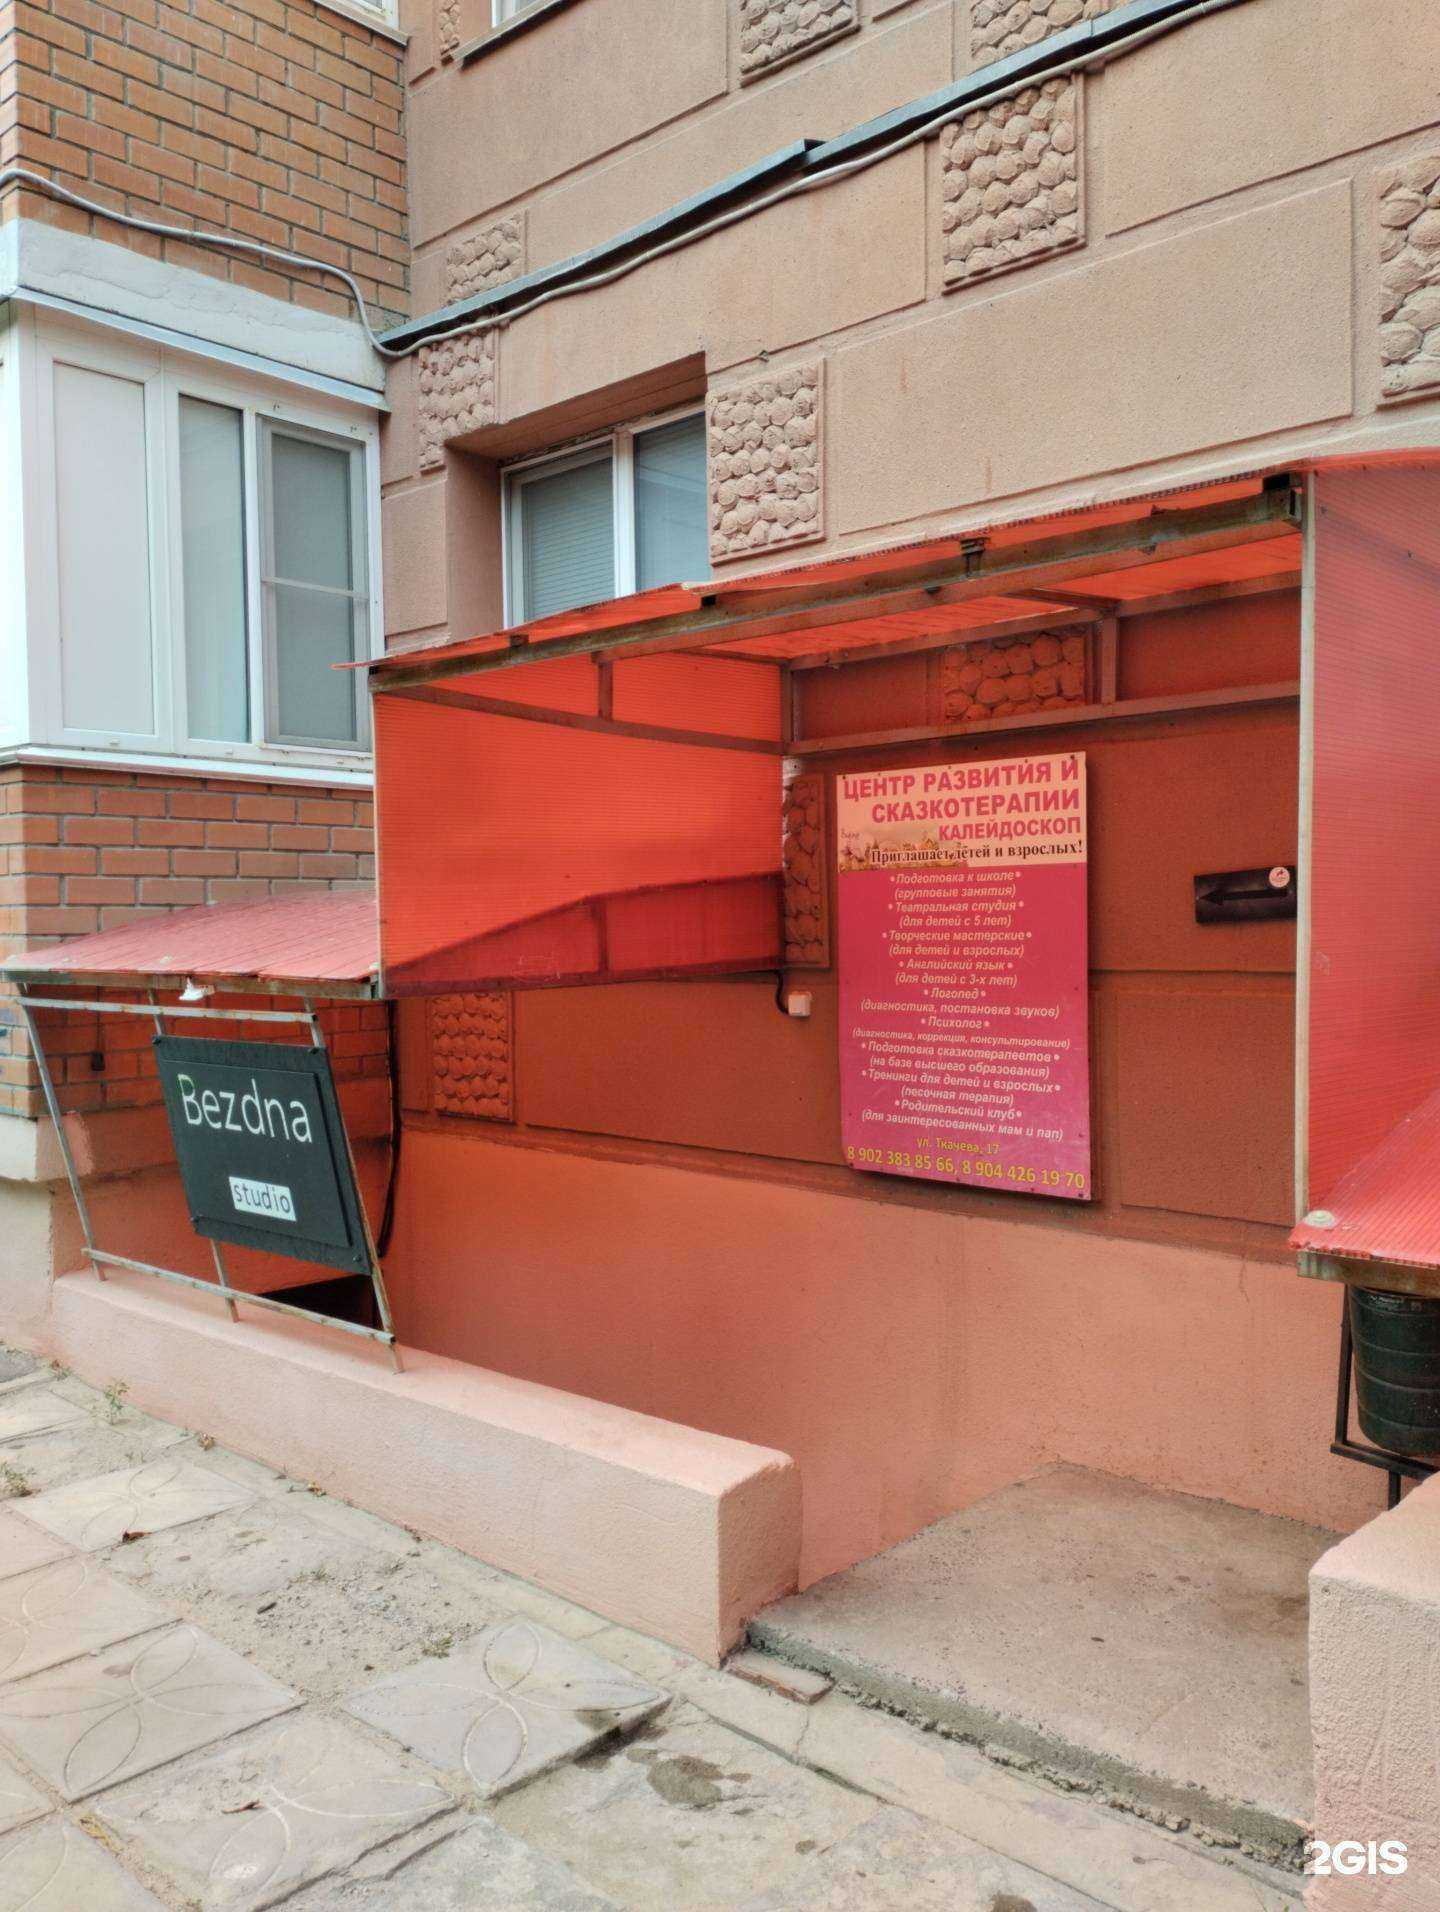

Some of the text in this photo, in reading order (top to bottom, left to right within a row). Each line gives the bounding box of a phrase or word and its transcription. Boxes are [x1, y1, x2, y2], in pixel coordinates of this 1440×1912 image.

[844, 760, 1079, 802] ЦЕНТР РАЗВИТИЯ И
[872, 788, 1079, 823] СКАЗКОТЕРАПИИ
[939, 817, 1081, 841] КАЛЕЙДОСКОП
[872, 840, 1083, 866] Приглашает детей и взрослых!
[896, 873, 965, 886] Подготовка
[977, 873, 1014, 882] школе
[895, 886, 1016, 900] (групповые занятия)
[896, 901, 1016, 914] Театральная студия
[899, 916, 923, 927] (для
[926, 914, 961, 926] детей
[974, 916, 980, 925] 5
[983, 915, 1011, 926] лет)
[888, 930, 1025, 943] Творческие мастерские
[889, 944, 1024, 958] (для детей и взрослых)
[907, 959, 1005, 970] Английский язык
[896, 973, 918, 984] (для
[921, 974, 956, 985] детей
[969, 975, 986, 984] 3-х
[989, 975, 1018, 986] лет)
[931, 988, 979, 999] Логопед
[861, 999, 1059, 1018] (диагностика, постановка звуков)
[928, 1017, 982, 1029] Психолог
[853, 1029, 1070, 1049] (диагностика, коррекция, консультирование)
[868, 1042, 1051, 1062] Подготовка сказкотерапевтов
[870, 1057, 1049, 1079] (на базе высшего образования)
[868, 1069, 1053, 1093] Тренинги для детей и взрослых
[901, 1085, 1014, 1105] (песочная терапия)
[177, 1073, 313, 1143] Bezdna
[901, 1100, 1015, 1120] Родительский клуб
[862, 1110, 1063, 1140] (для заинтересованных мам и пап)
[917, 1137, 999, 1154] ул. Ткачева, 17
[847, 1147, 1085, 1189] 8 902 383 85 66, 8 904 426 19 70
[234, 1183, 291, 1214] studio
